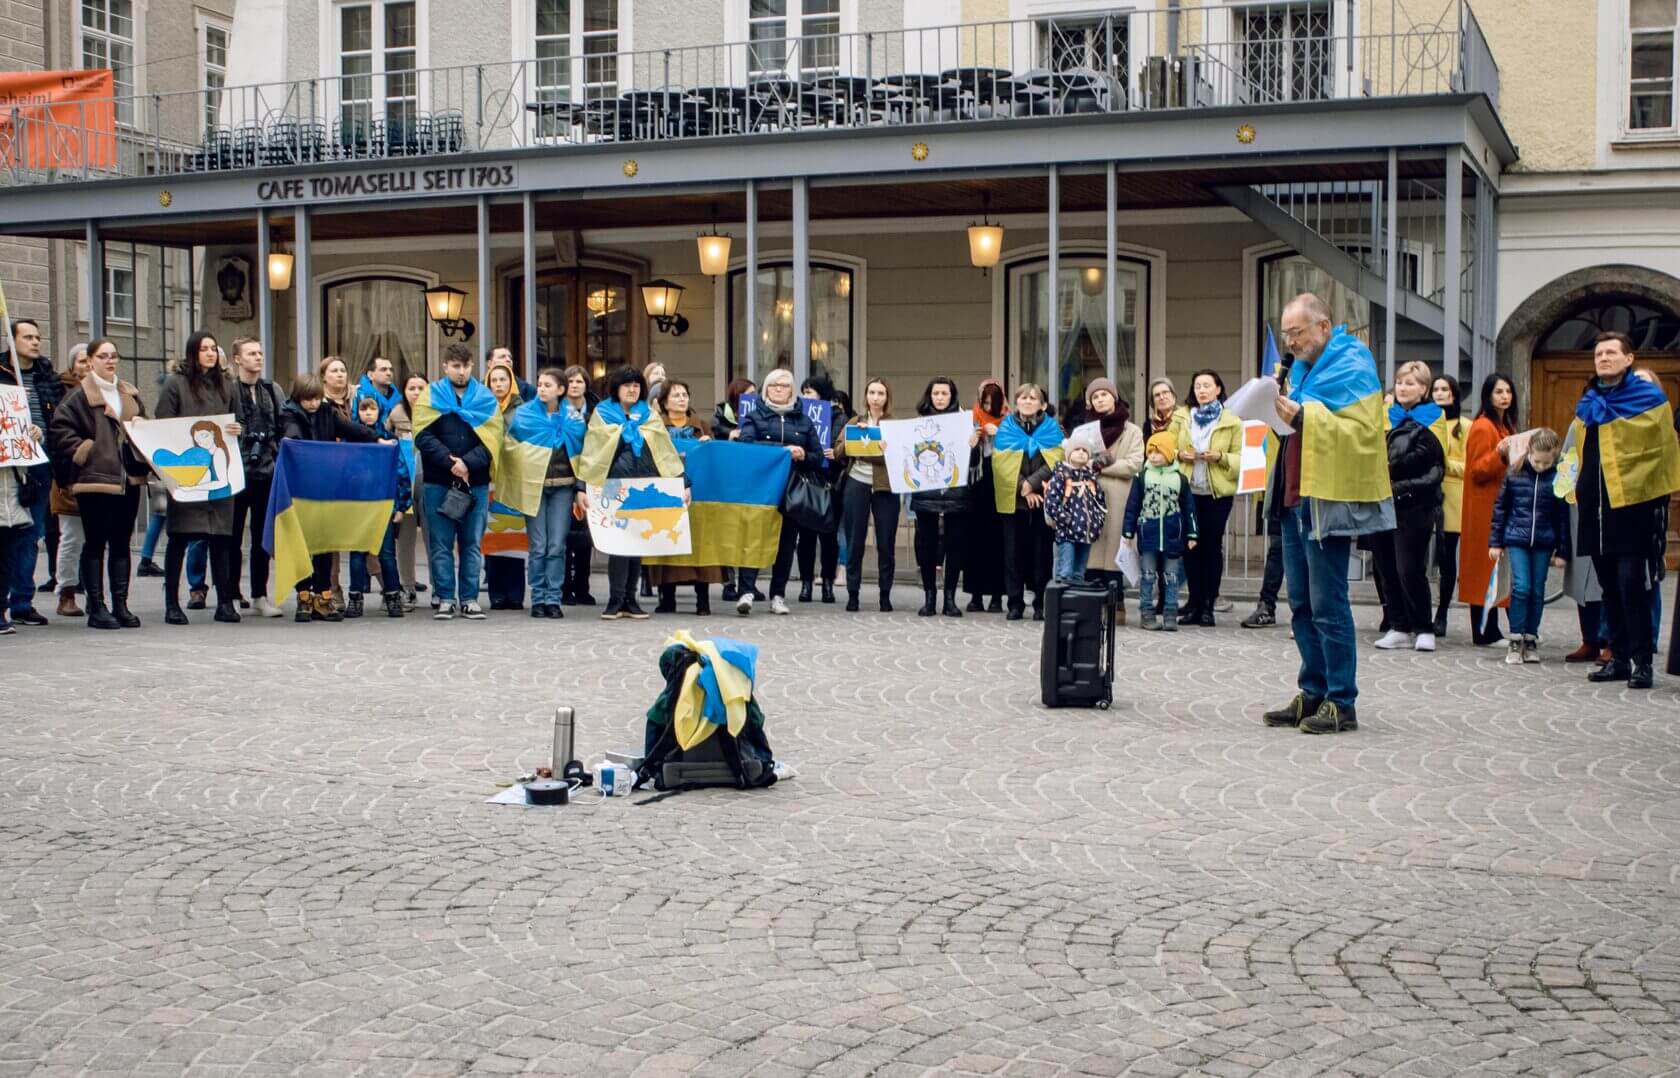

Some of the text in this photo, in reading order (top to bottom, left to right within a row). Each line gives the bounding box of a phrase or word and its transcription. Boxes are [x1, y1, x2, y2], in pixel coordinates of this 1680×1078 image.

[257, 166, 514, 201] CAFE TOMASELLI SEIT 1703
